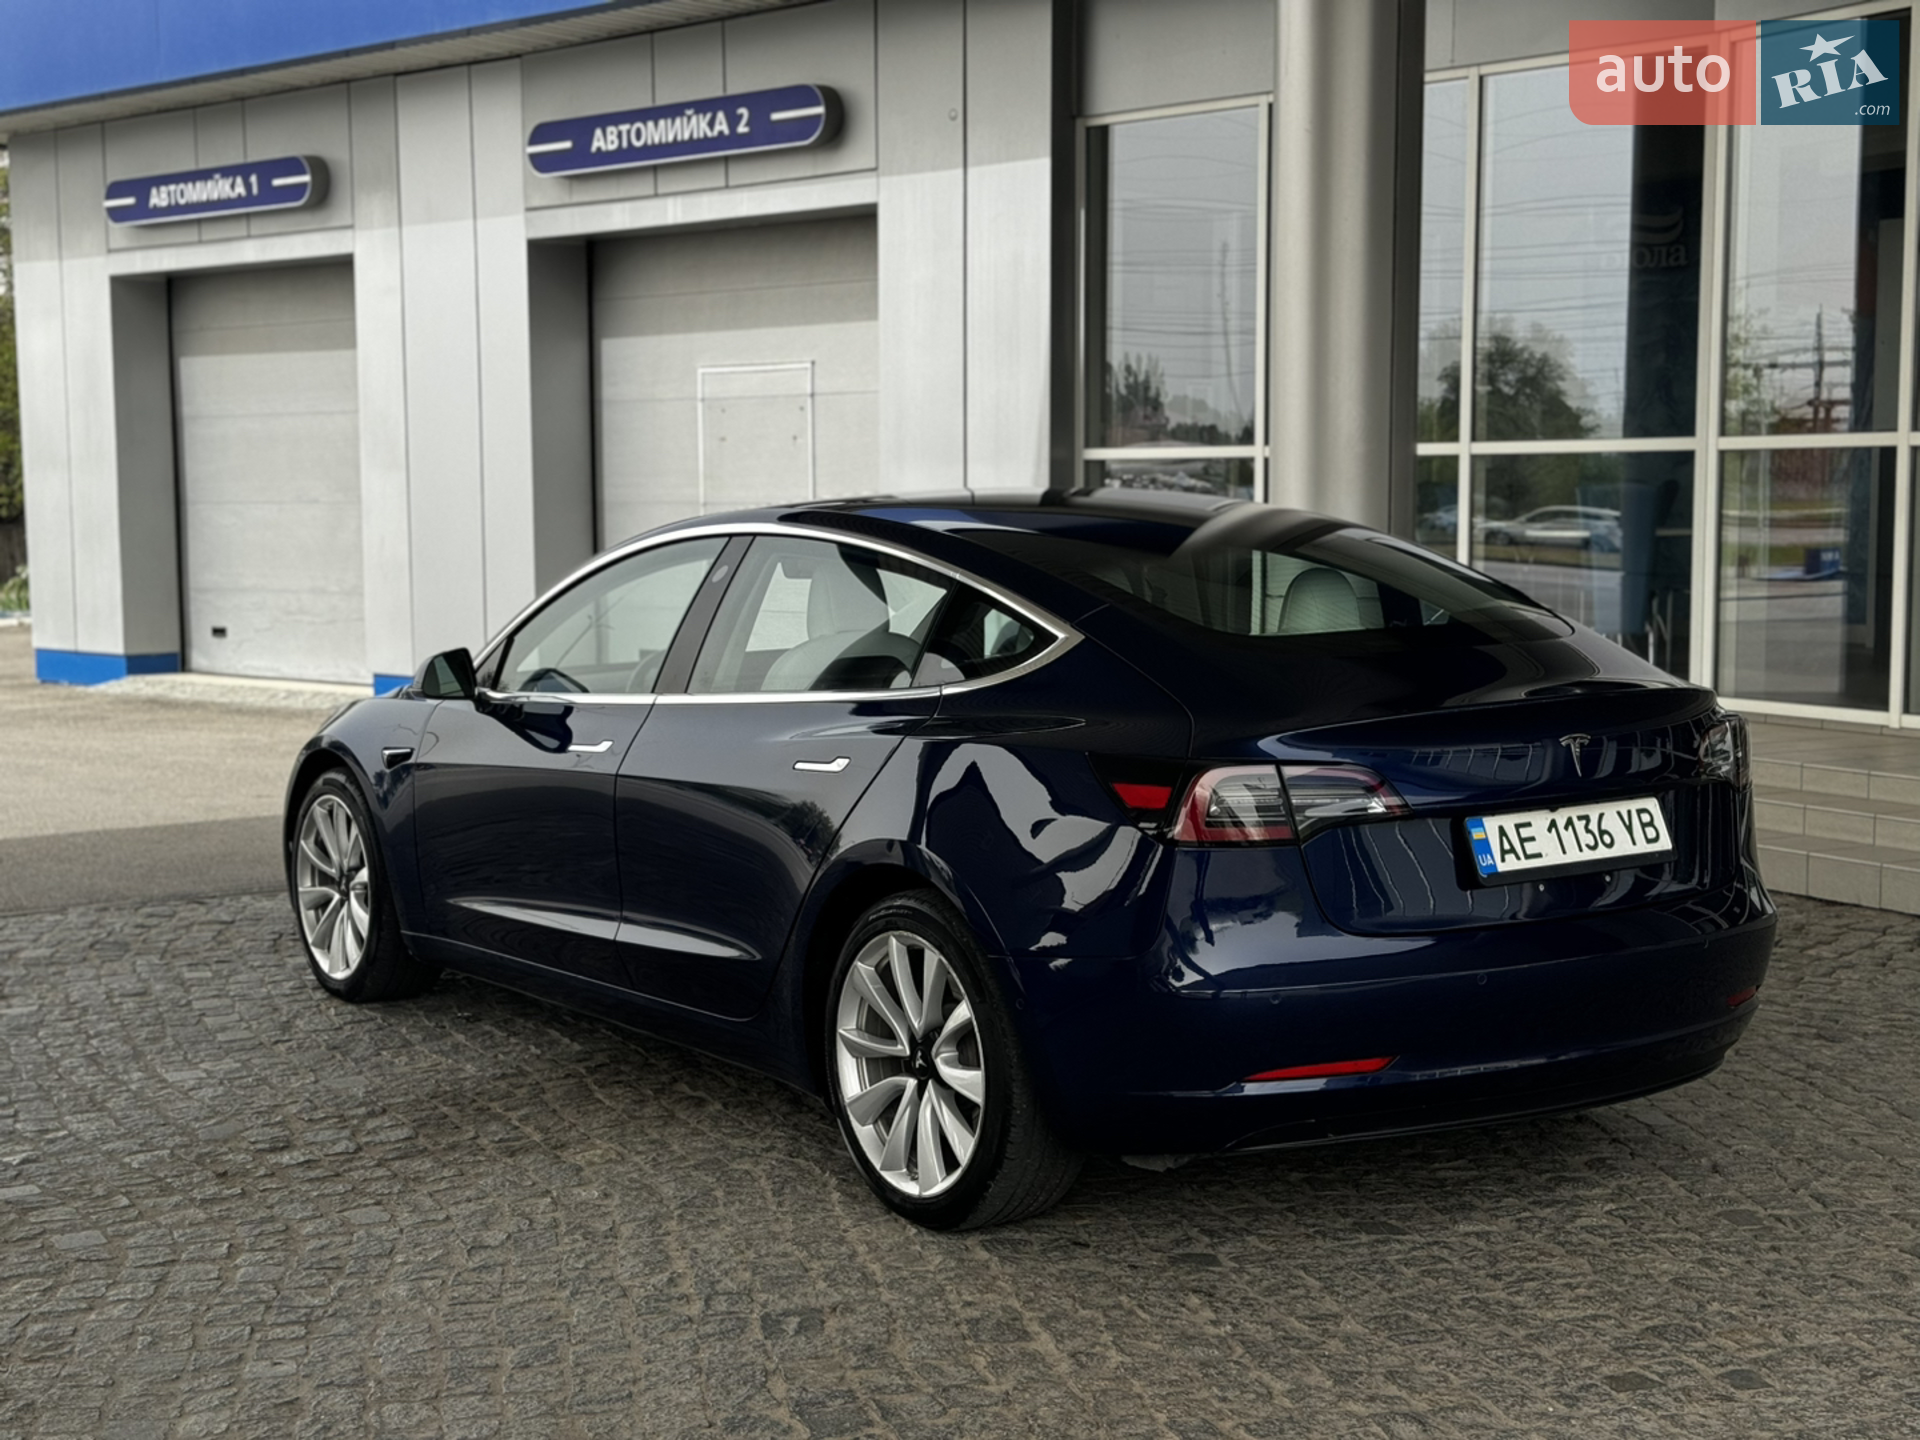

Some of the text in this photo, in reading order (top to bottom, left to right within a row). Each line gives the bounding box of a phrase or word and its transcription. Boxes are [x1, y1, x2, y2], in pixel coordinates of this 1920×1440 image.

[590, 107, 750, 153] АВТОМИЙКА 2
[148, 173, 258, 209] АВТОМИЙКА 1
[1498, 807, 1660, 863] AE 1136 YB
[1479, 853, 1495, 867] UA
